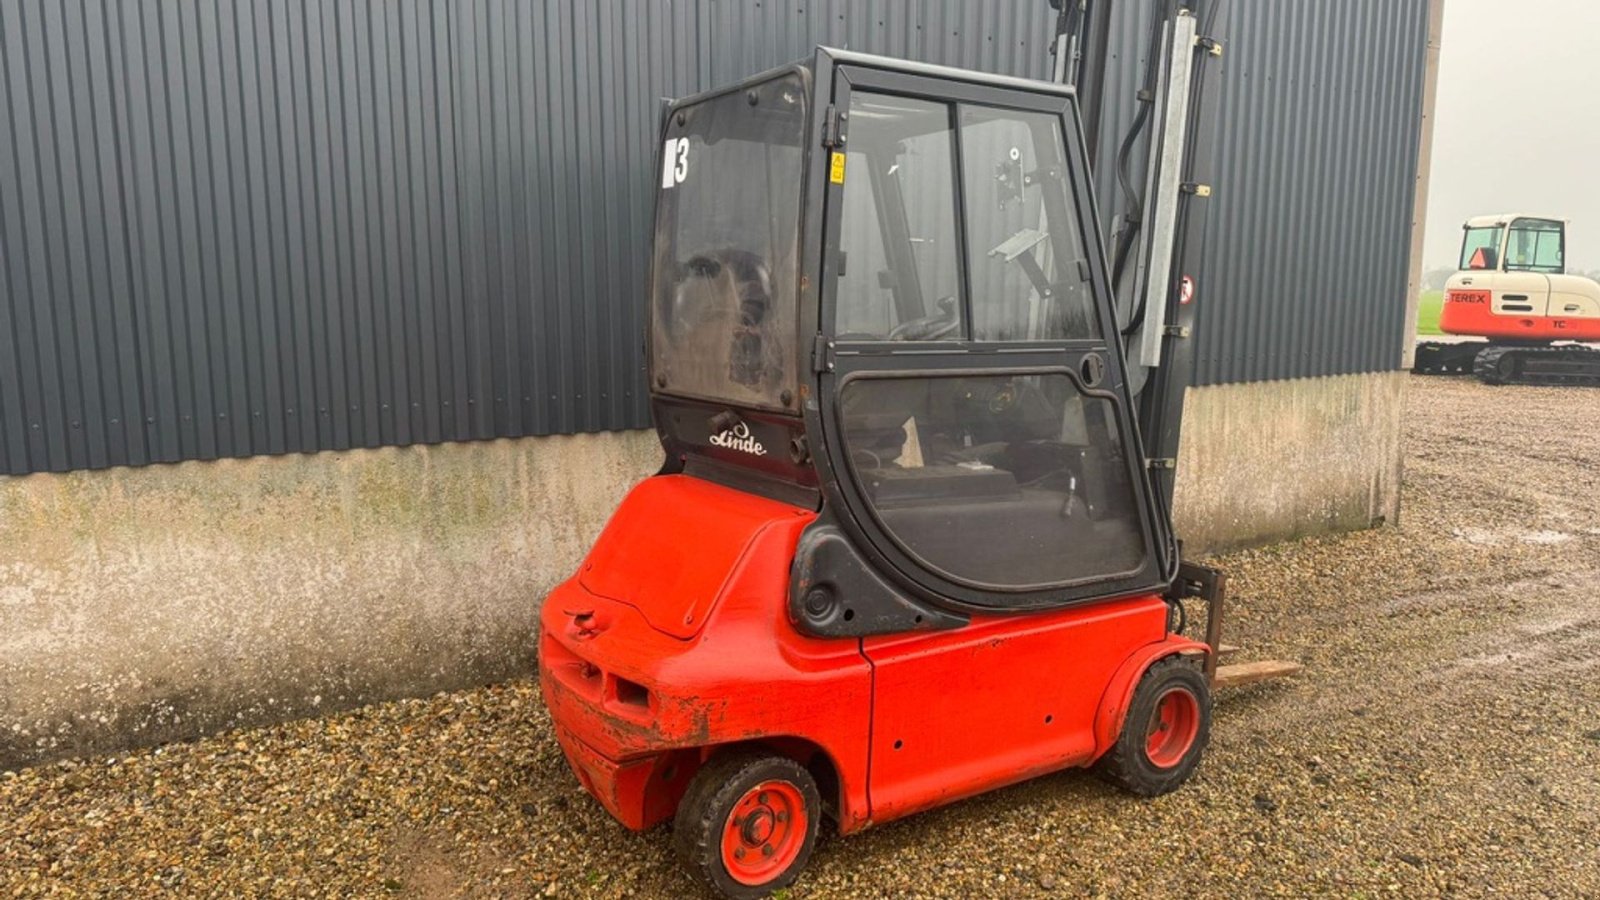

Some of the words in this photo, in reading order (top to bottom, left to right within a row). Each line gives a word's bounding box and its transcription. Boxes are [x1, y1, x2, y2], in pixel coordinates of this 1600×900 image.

[1450, 293, 1485, 303] TEREX
[1553, 320, 1566, 328] TC
[709, 429, 767, 455] Linde
